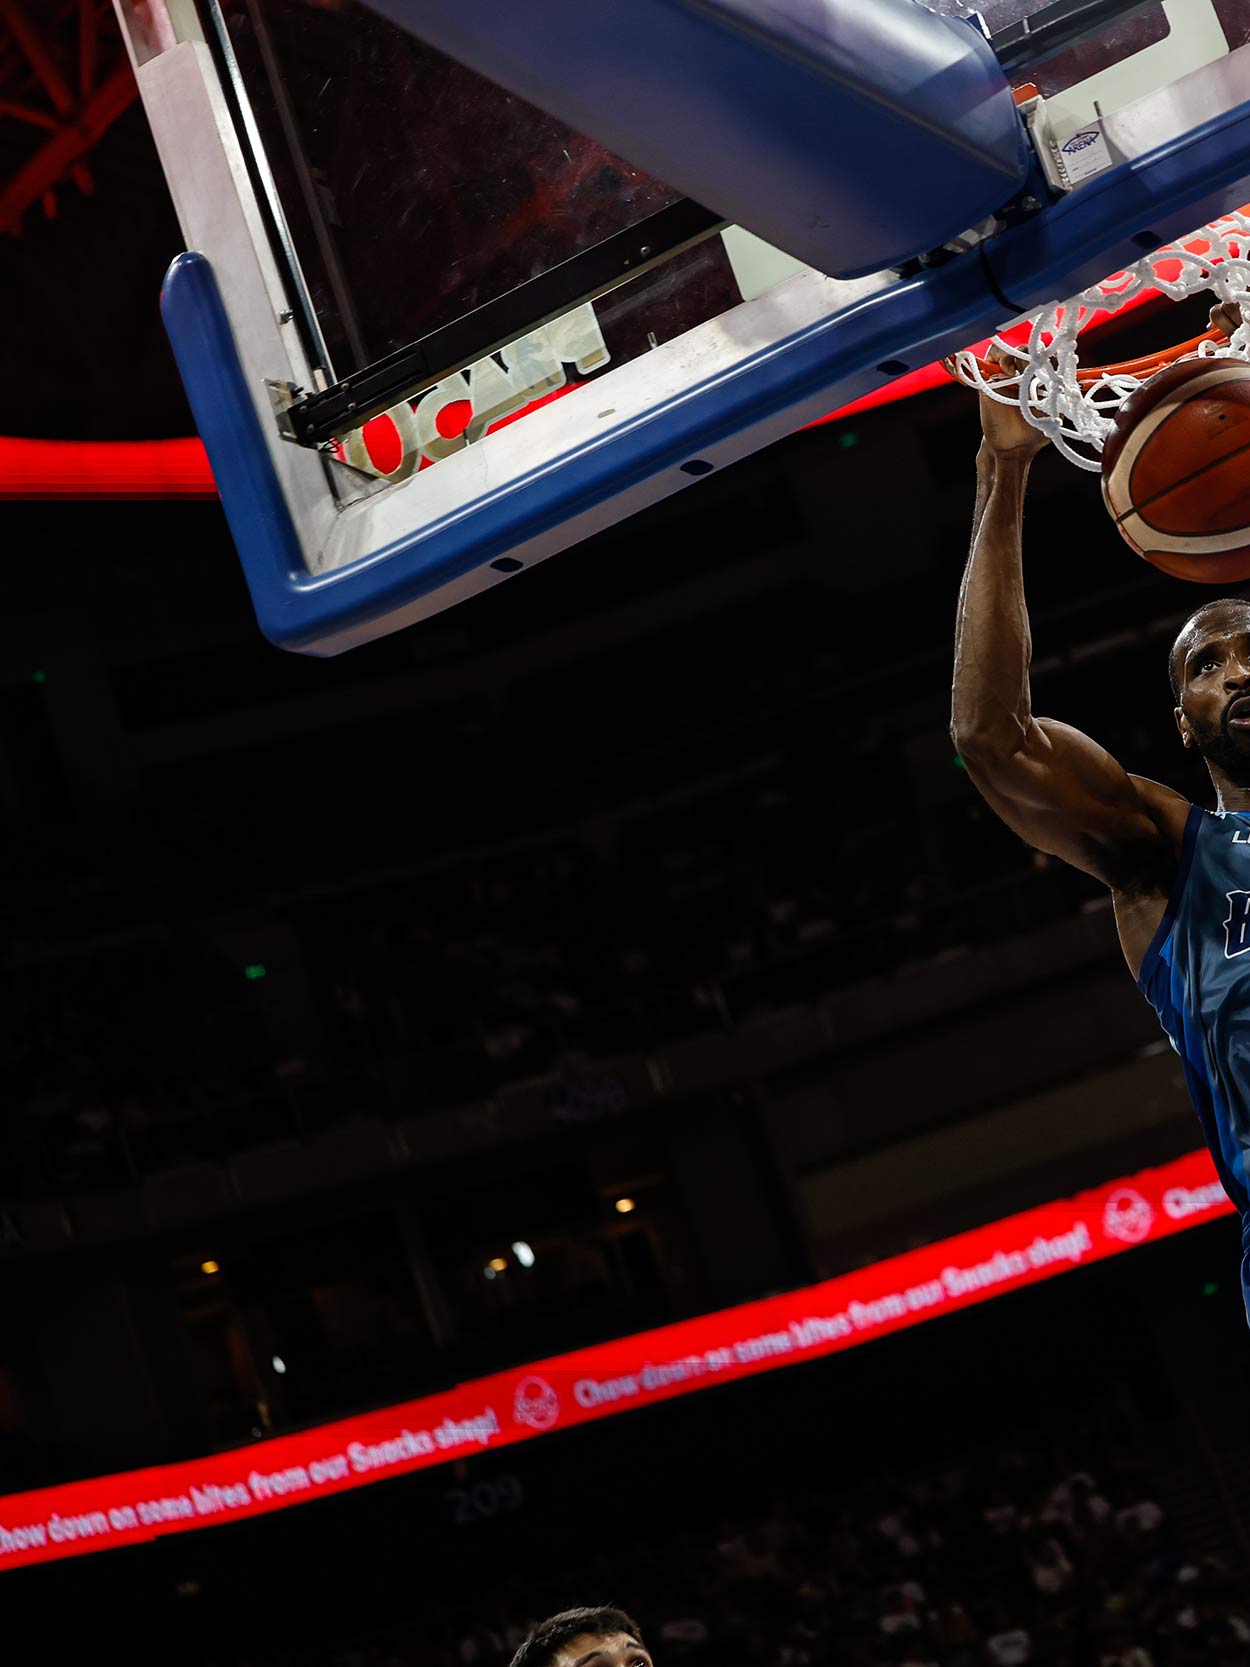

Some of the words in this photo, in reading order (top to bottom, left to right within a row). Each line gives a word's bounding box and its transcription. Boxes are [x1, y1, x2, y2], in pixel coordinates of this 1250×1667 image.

[848, 1299, 907, 1329] from
[904, 1279, 946, 1311] our
[940, 1250, 1029, 1297] Snacks
[1027, 1220, 1093, 1269] shop!
[0, 1522, 47, 1553] how
[48, 1513, 110, 1544] down
[108, 1505, 139, 1531] on
[136, 1495, 195, 1525] some
[189, 1484, 251, 1515] bites
[248, 1470, 310, 1501] from
[308, 1454, 348, 1485] our
[347, 1429, 435, 1473] Snacks
[433, 1406, 499, 1450] shop!
